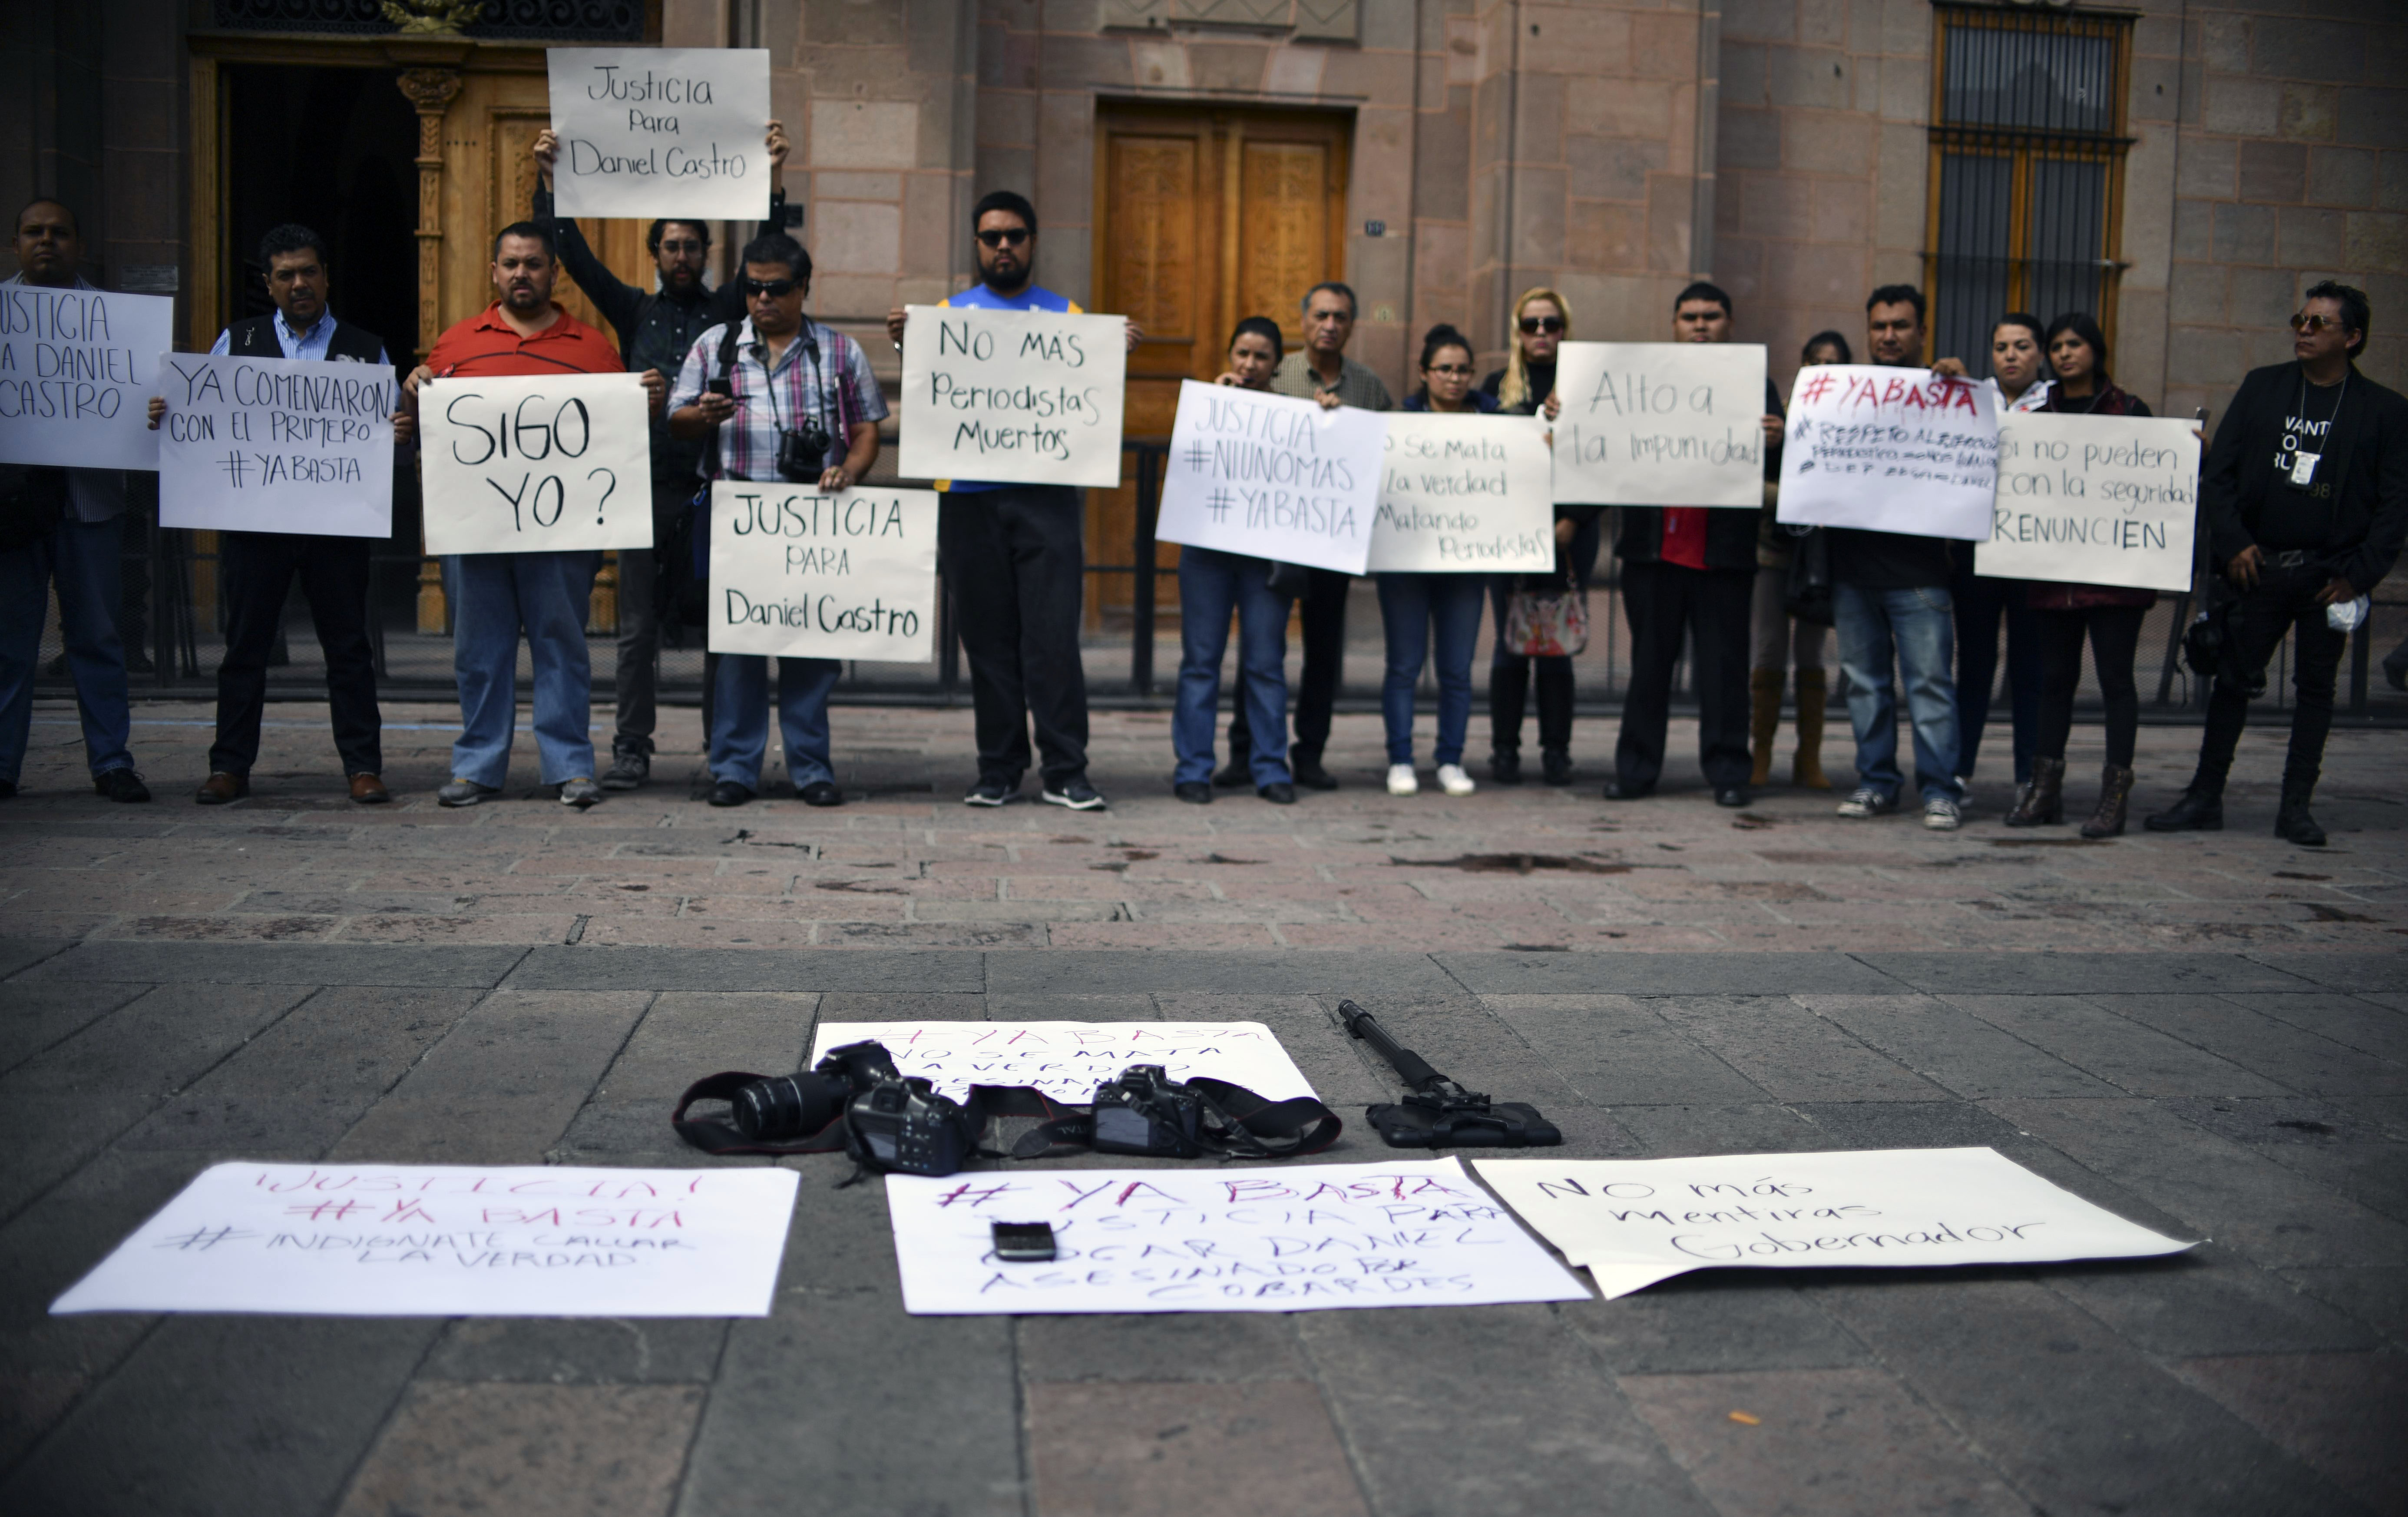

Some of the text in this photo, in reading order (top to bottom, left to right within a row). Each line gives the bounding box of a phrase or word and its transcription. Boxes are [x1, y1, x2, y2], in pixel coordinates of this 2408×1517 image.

[588, 66, 713, 105] Justicia
[571, 139, 747, 179] Daniel Castro
[939, 320, 993, 361] NO
[36, 343, 141, 385] DANIEL
[0, 380, 120, 418] CASTRO
[170, 361, 390, 423] YA COMENZARON
[931, 371, 1101, 426] Periodistas
[1589, 370, 1713, 416] Alto a
[171, 413, 215, 442] CON
[271, 411, 370, 448] PRIMERO
[447, 394, 589, 465] SIGO
[954, 419, 1069, 460] Muertos
[1195, 397, 1317, 453] JUSTICIA
[2034, 440, 2069, 461] no
[2085, 438, 2177, 471] pueden
[2063, 468, 2085, 498] la
[2101, 474, 2193, 515] seguridad
[734, 494, 903, 538] JUSTICIA
[1995, 507, 2166, 550] RENUNCIEN
[786, 545, 850, 576] PARA
[726, 589, 919, 637] Daniel Castro
[1065, 1030, 1264, 1045] BASTA
[1073, 1047, 1222, 1059] MATA
[971, 1063, 1191, 1073] VERDD
[1058, 1179, 1188, 1212] YA
[1215, 1174, 1474, 1203] BASTA
[1688, 1176, 1813, 1198] más
[481, 1207, 682, 1228] BASTA
[1608, 1205, 1882, 1226] mentiras
[456, 1252, 637, 1268] VERDAD
[1259, 1227, 1507, 1257] DANIEL
[1670, 1221, 2047, 1260] Gobernador
[1147, 1273, 1474, 1300] COBARDES
